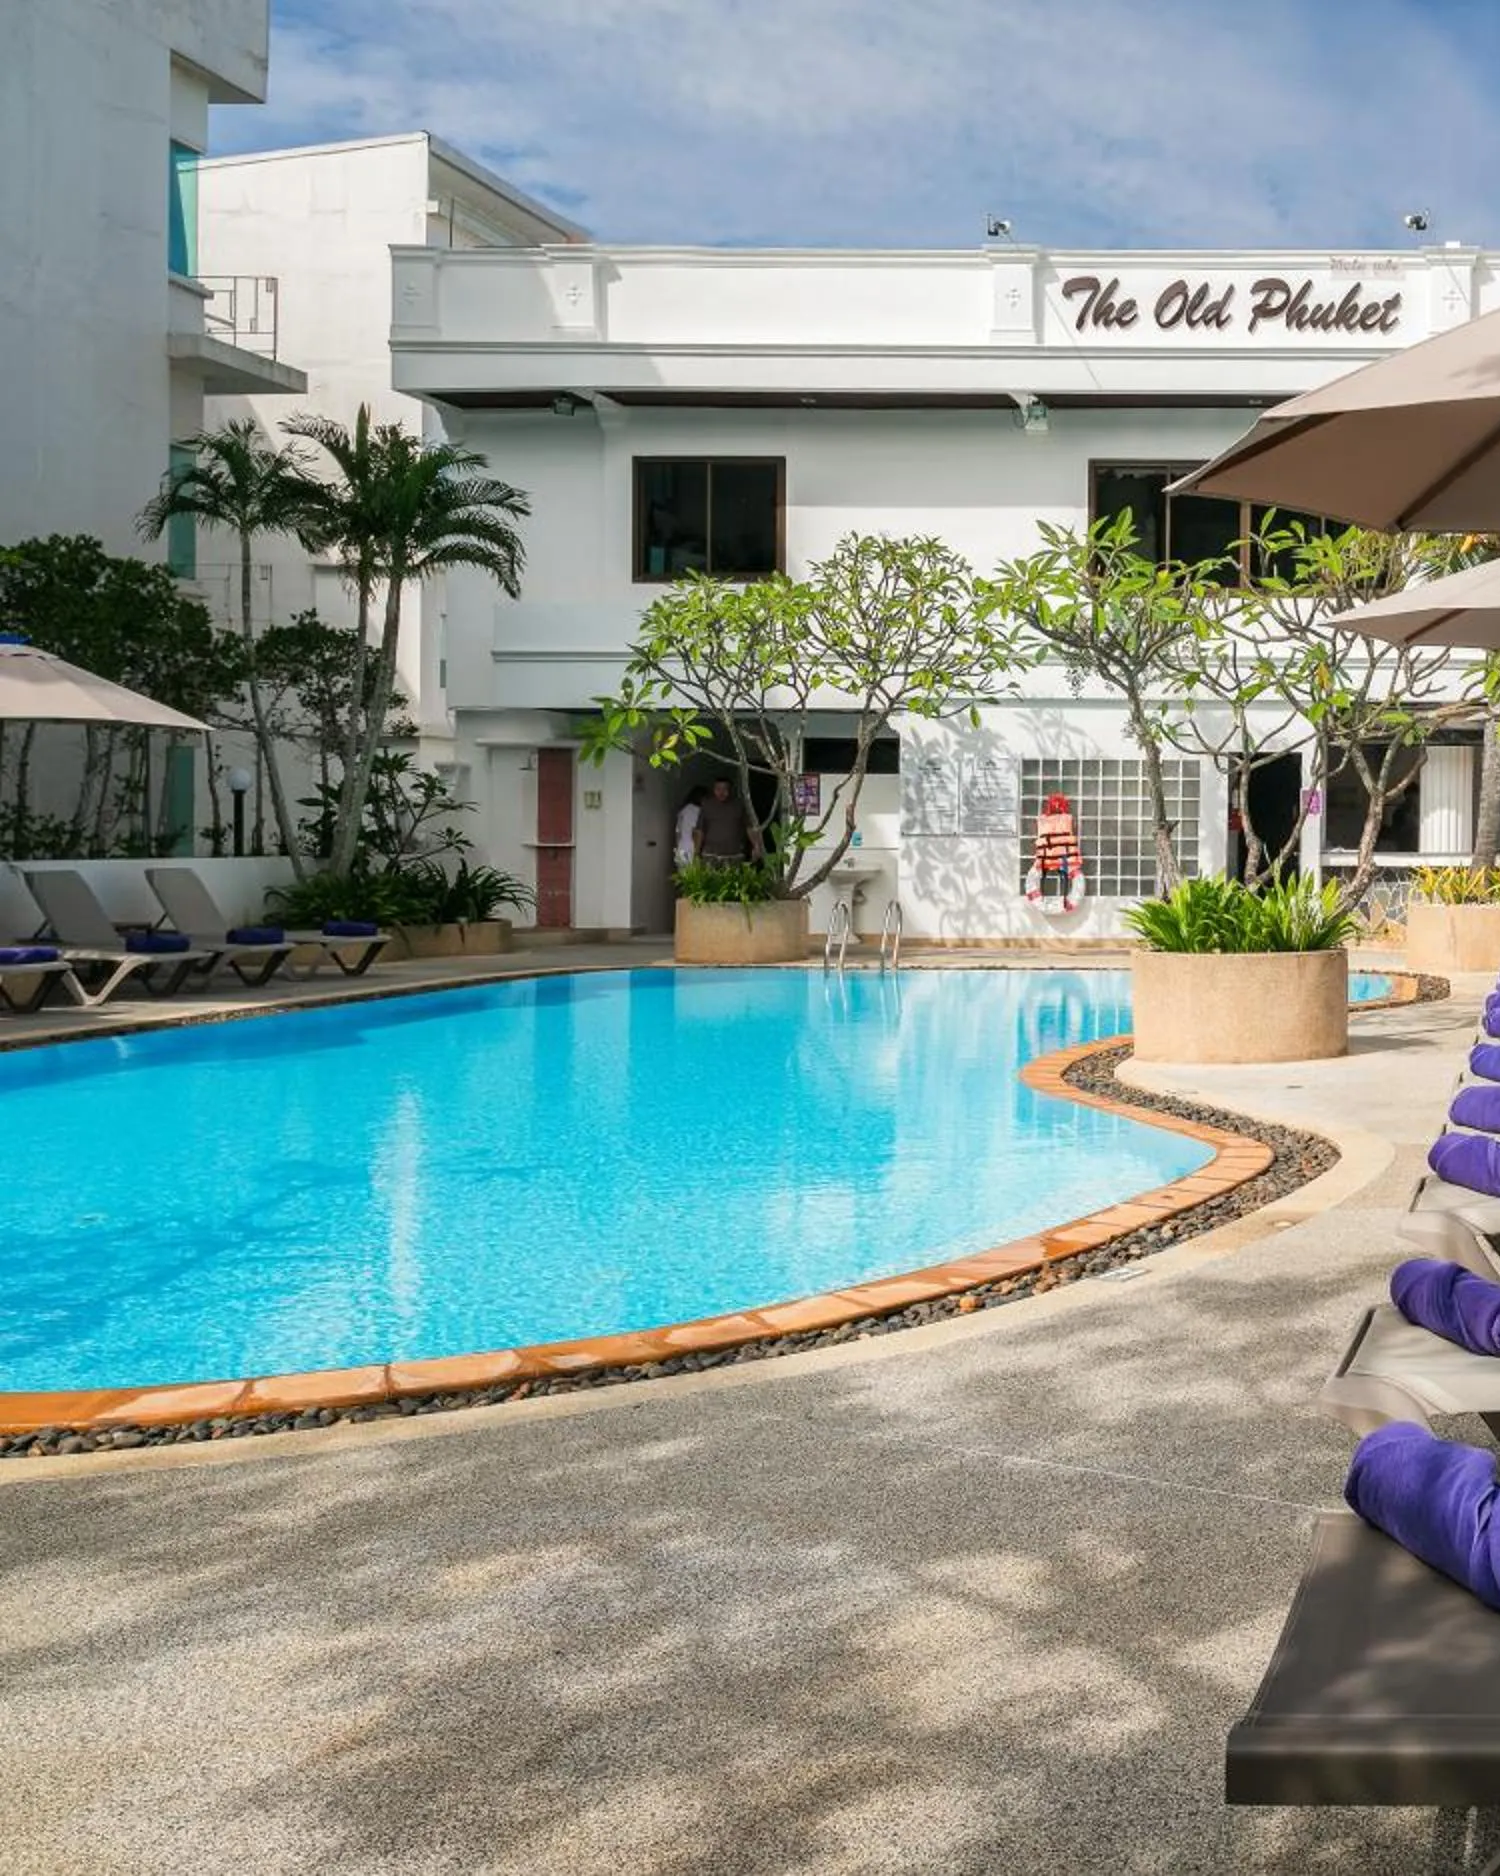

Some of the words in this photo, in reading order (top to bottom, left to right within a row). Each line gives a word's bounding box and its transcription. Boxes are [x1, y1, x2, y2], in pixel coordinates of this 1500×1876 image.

[1062, 276, 1138, 332] The
[1154, 279, 1235, 330] Old
[1248, 277, 1402, 333] Phuket
